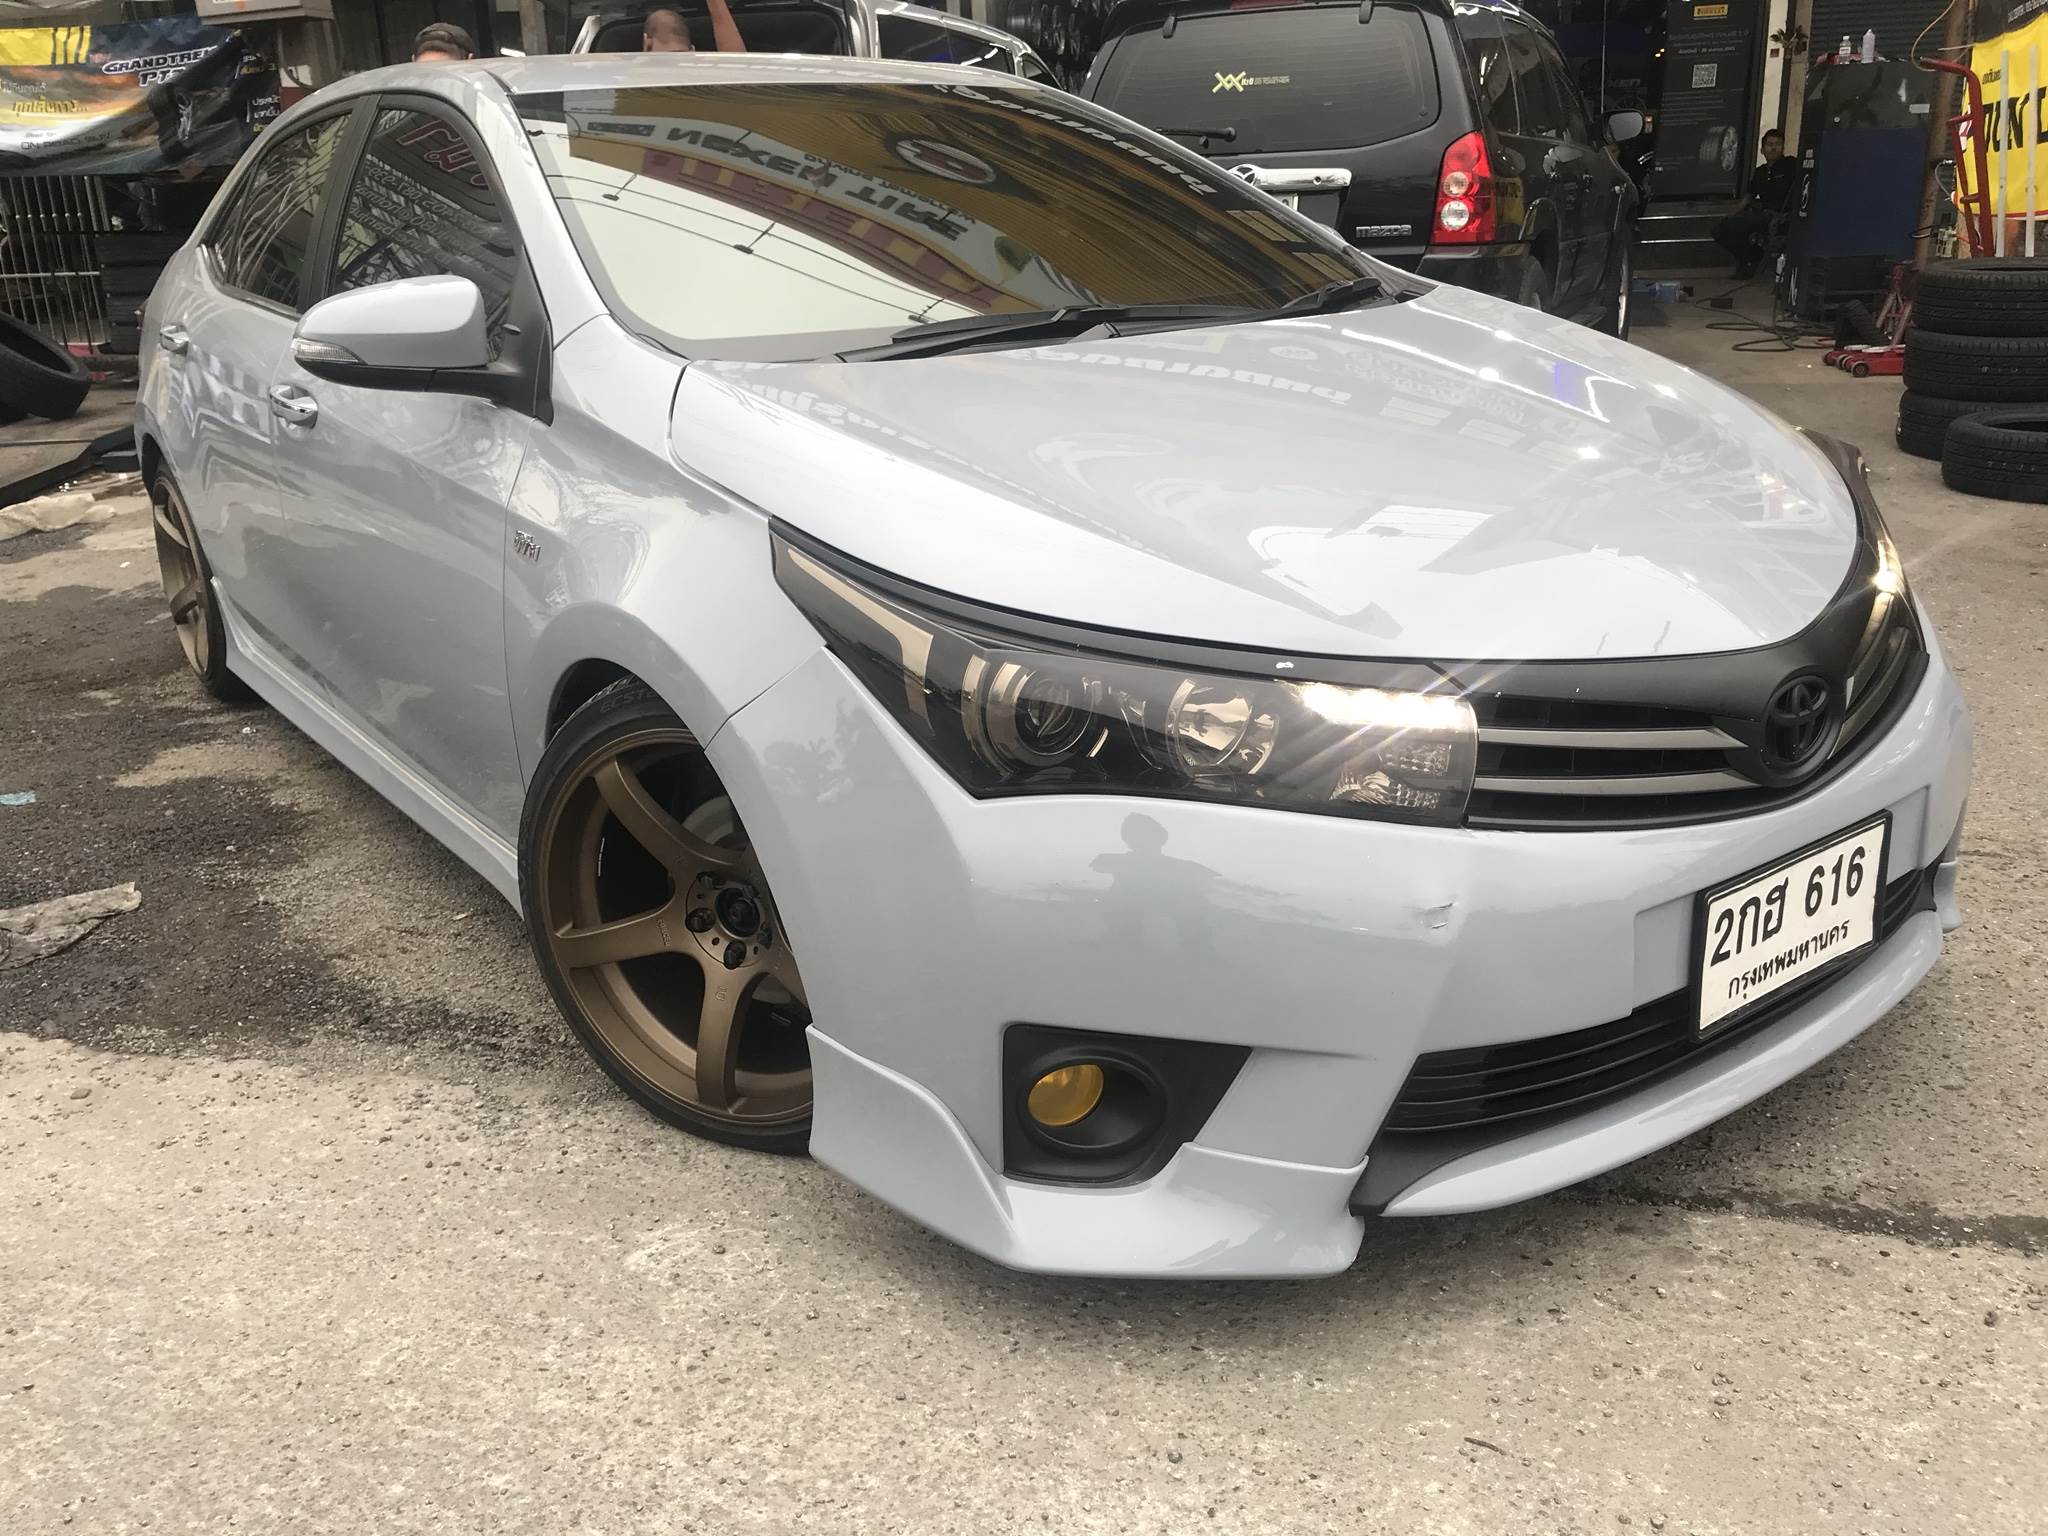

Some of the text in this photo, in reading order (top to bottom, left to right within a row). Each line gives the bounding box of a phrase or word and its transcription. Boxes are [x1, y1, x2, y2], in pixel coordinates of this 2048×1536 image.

[1710, 845, 1866, 968] 2กฮ 616
[1727, 919, 1850, 1000] กรุงเทพมหานคร
